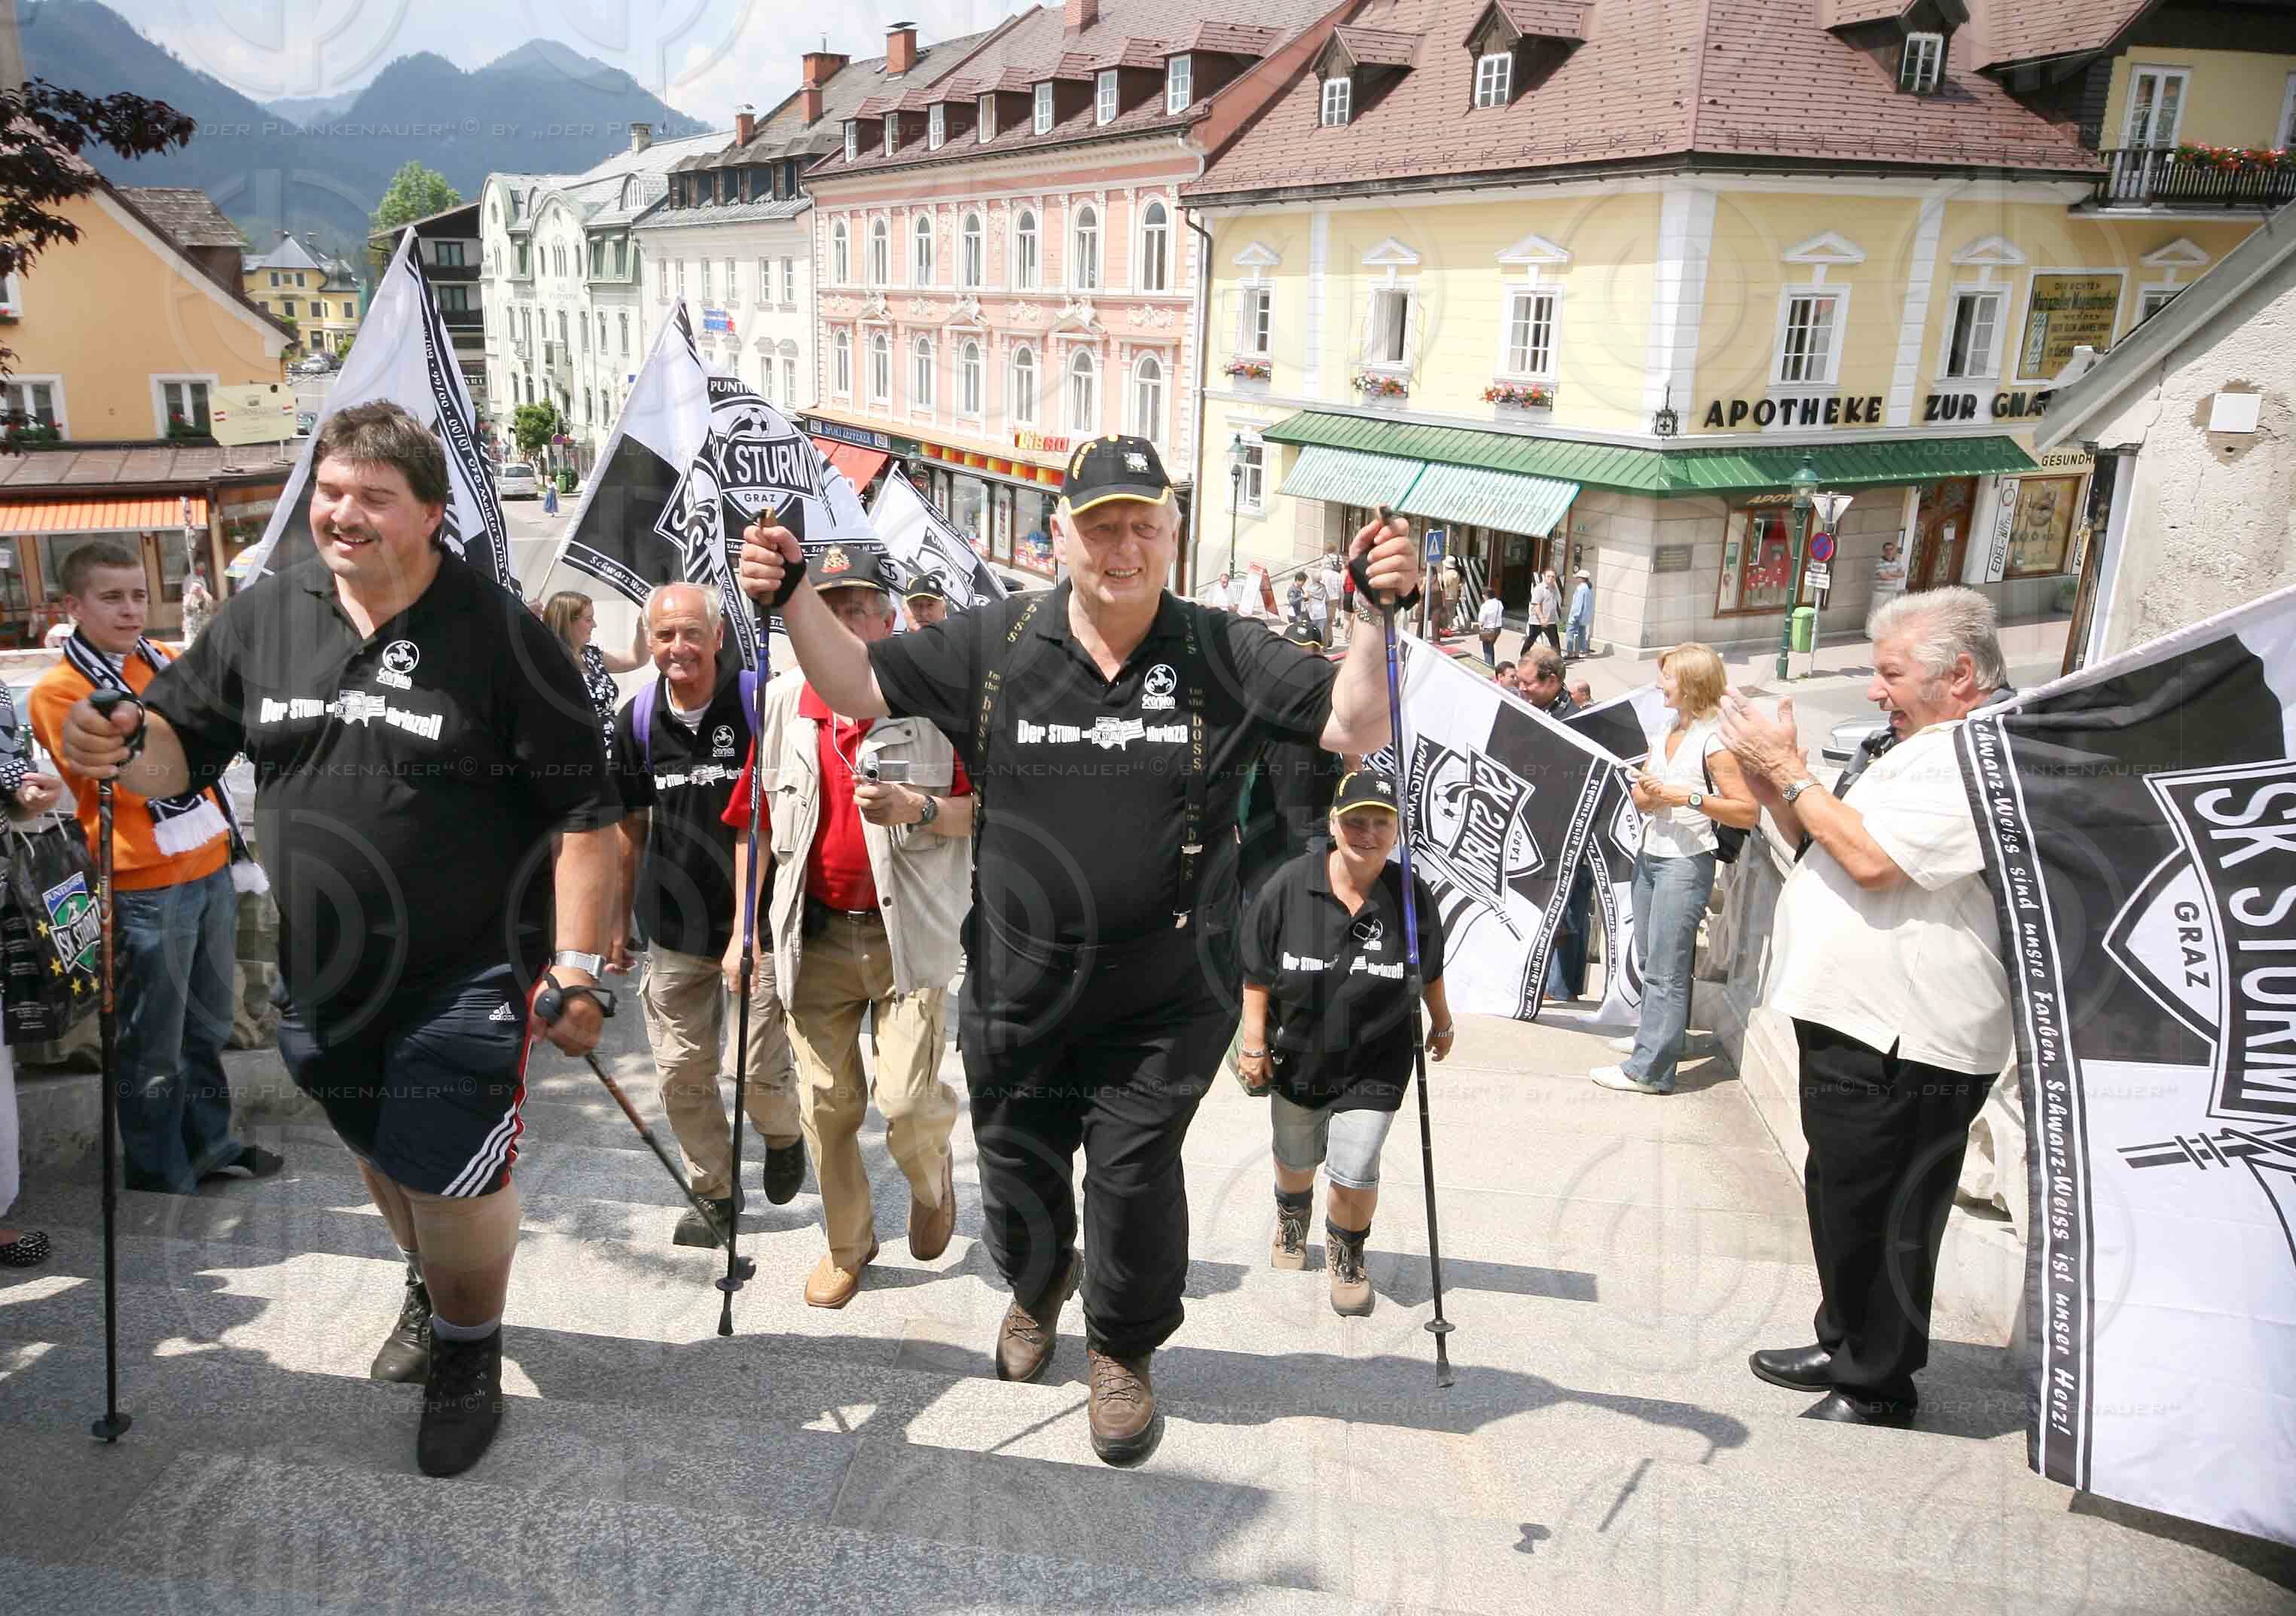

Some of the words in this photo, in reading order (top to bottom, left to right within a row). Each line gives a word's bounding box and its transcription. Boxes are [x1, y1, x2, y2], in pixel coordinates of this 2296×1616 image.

[1704, 396, 1882, 429] APOTHEKE
[1924, 392, 1978, 420] ZUR
[734, 441, 812, 490] STURM
[744, 493, 777, 503] GRAZ
[1141, 694, 1176, 710] Scorpion
[1018, 719, 1046, 744] Der
[1048, 723, 1080, 743] STURM
[1146, 724, 1189, 744] Mariaze
[1625, 814, 1638, 842] GRA
[2194, 782, 2296, 869] SK
[2009, 866, 2040, 910] sind
[2023, 922, 2045, 979] unsre
[2173, 900, 2211, 989] GRAZ
[2033, 990, 2059, 1068] Farben,
[2046, 1079, 2075, 1242] Schwarz-Weiss
[2051, 1252, 2075, 1283] ist
[2053, 1292, 2072, 1356] unser
[2051, 1367, 2076, 1436] Herz!
